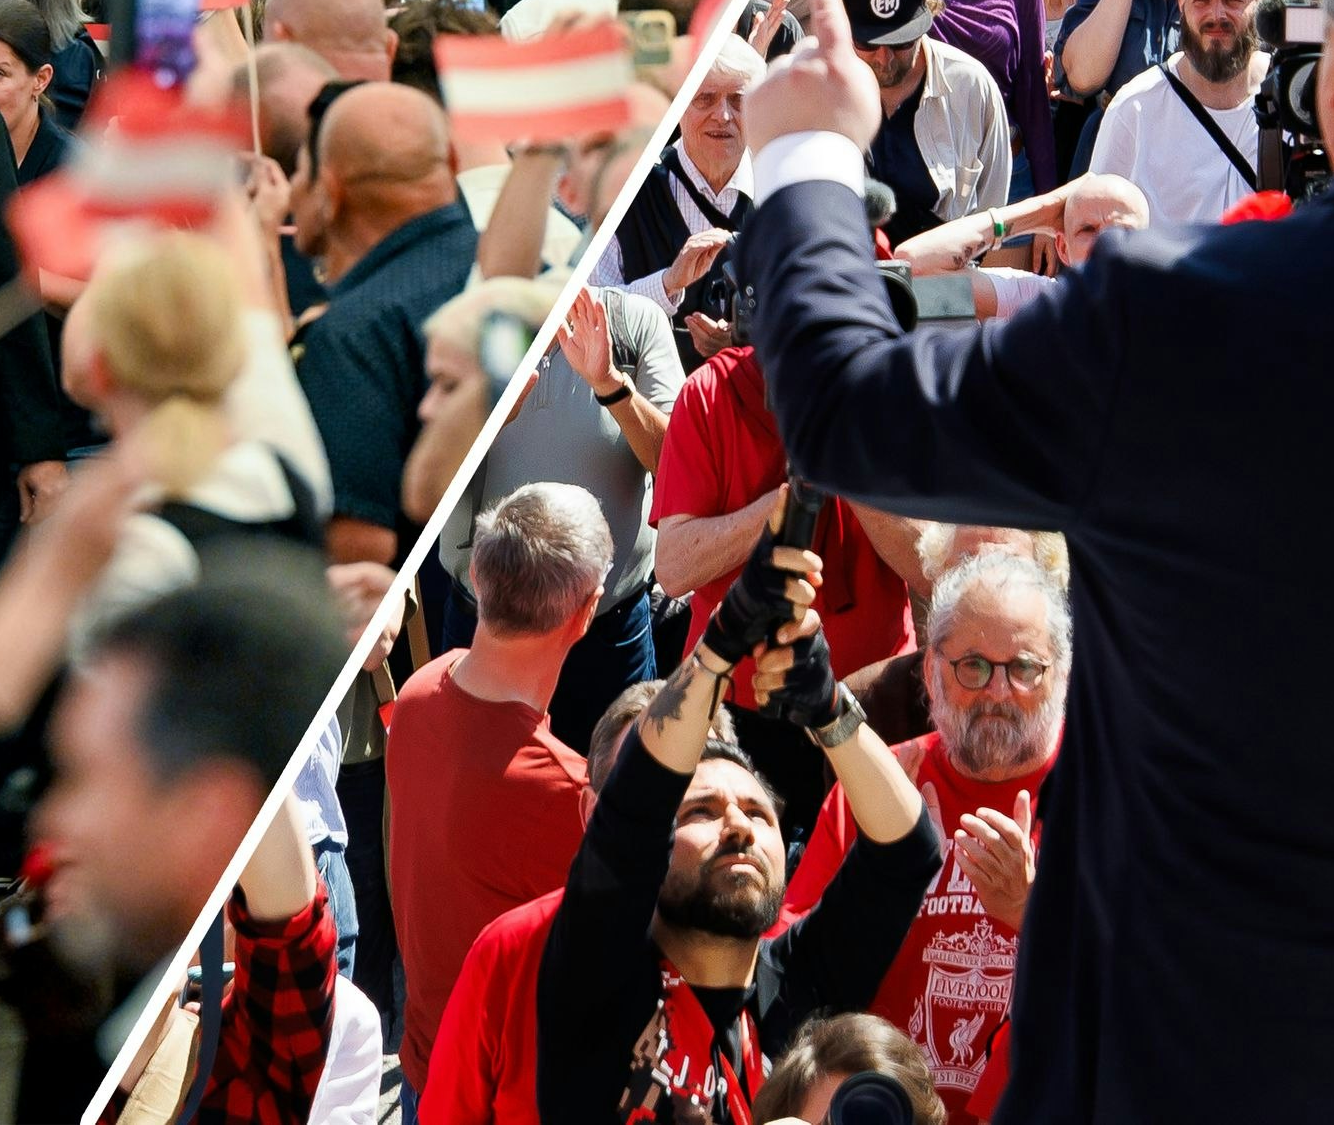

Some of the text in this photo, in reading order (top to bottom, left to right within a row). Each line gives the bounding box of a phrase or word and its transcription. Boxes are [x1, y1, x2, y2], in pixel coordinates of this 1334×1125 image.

[933, 977, 1007, 1000] LIVEROOL
[978, 1001, 1004, 1012] CLUB
[954, 1073, 977, 1088] 1892
